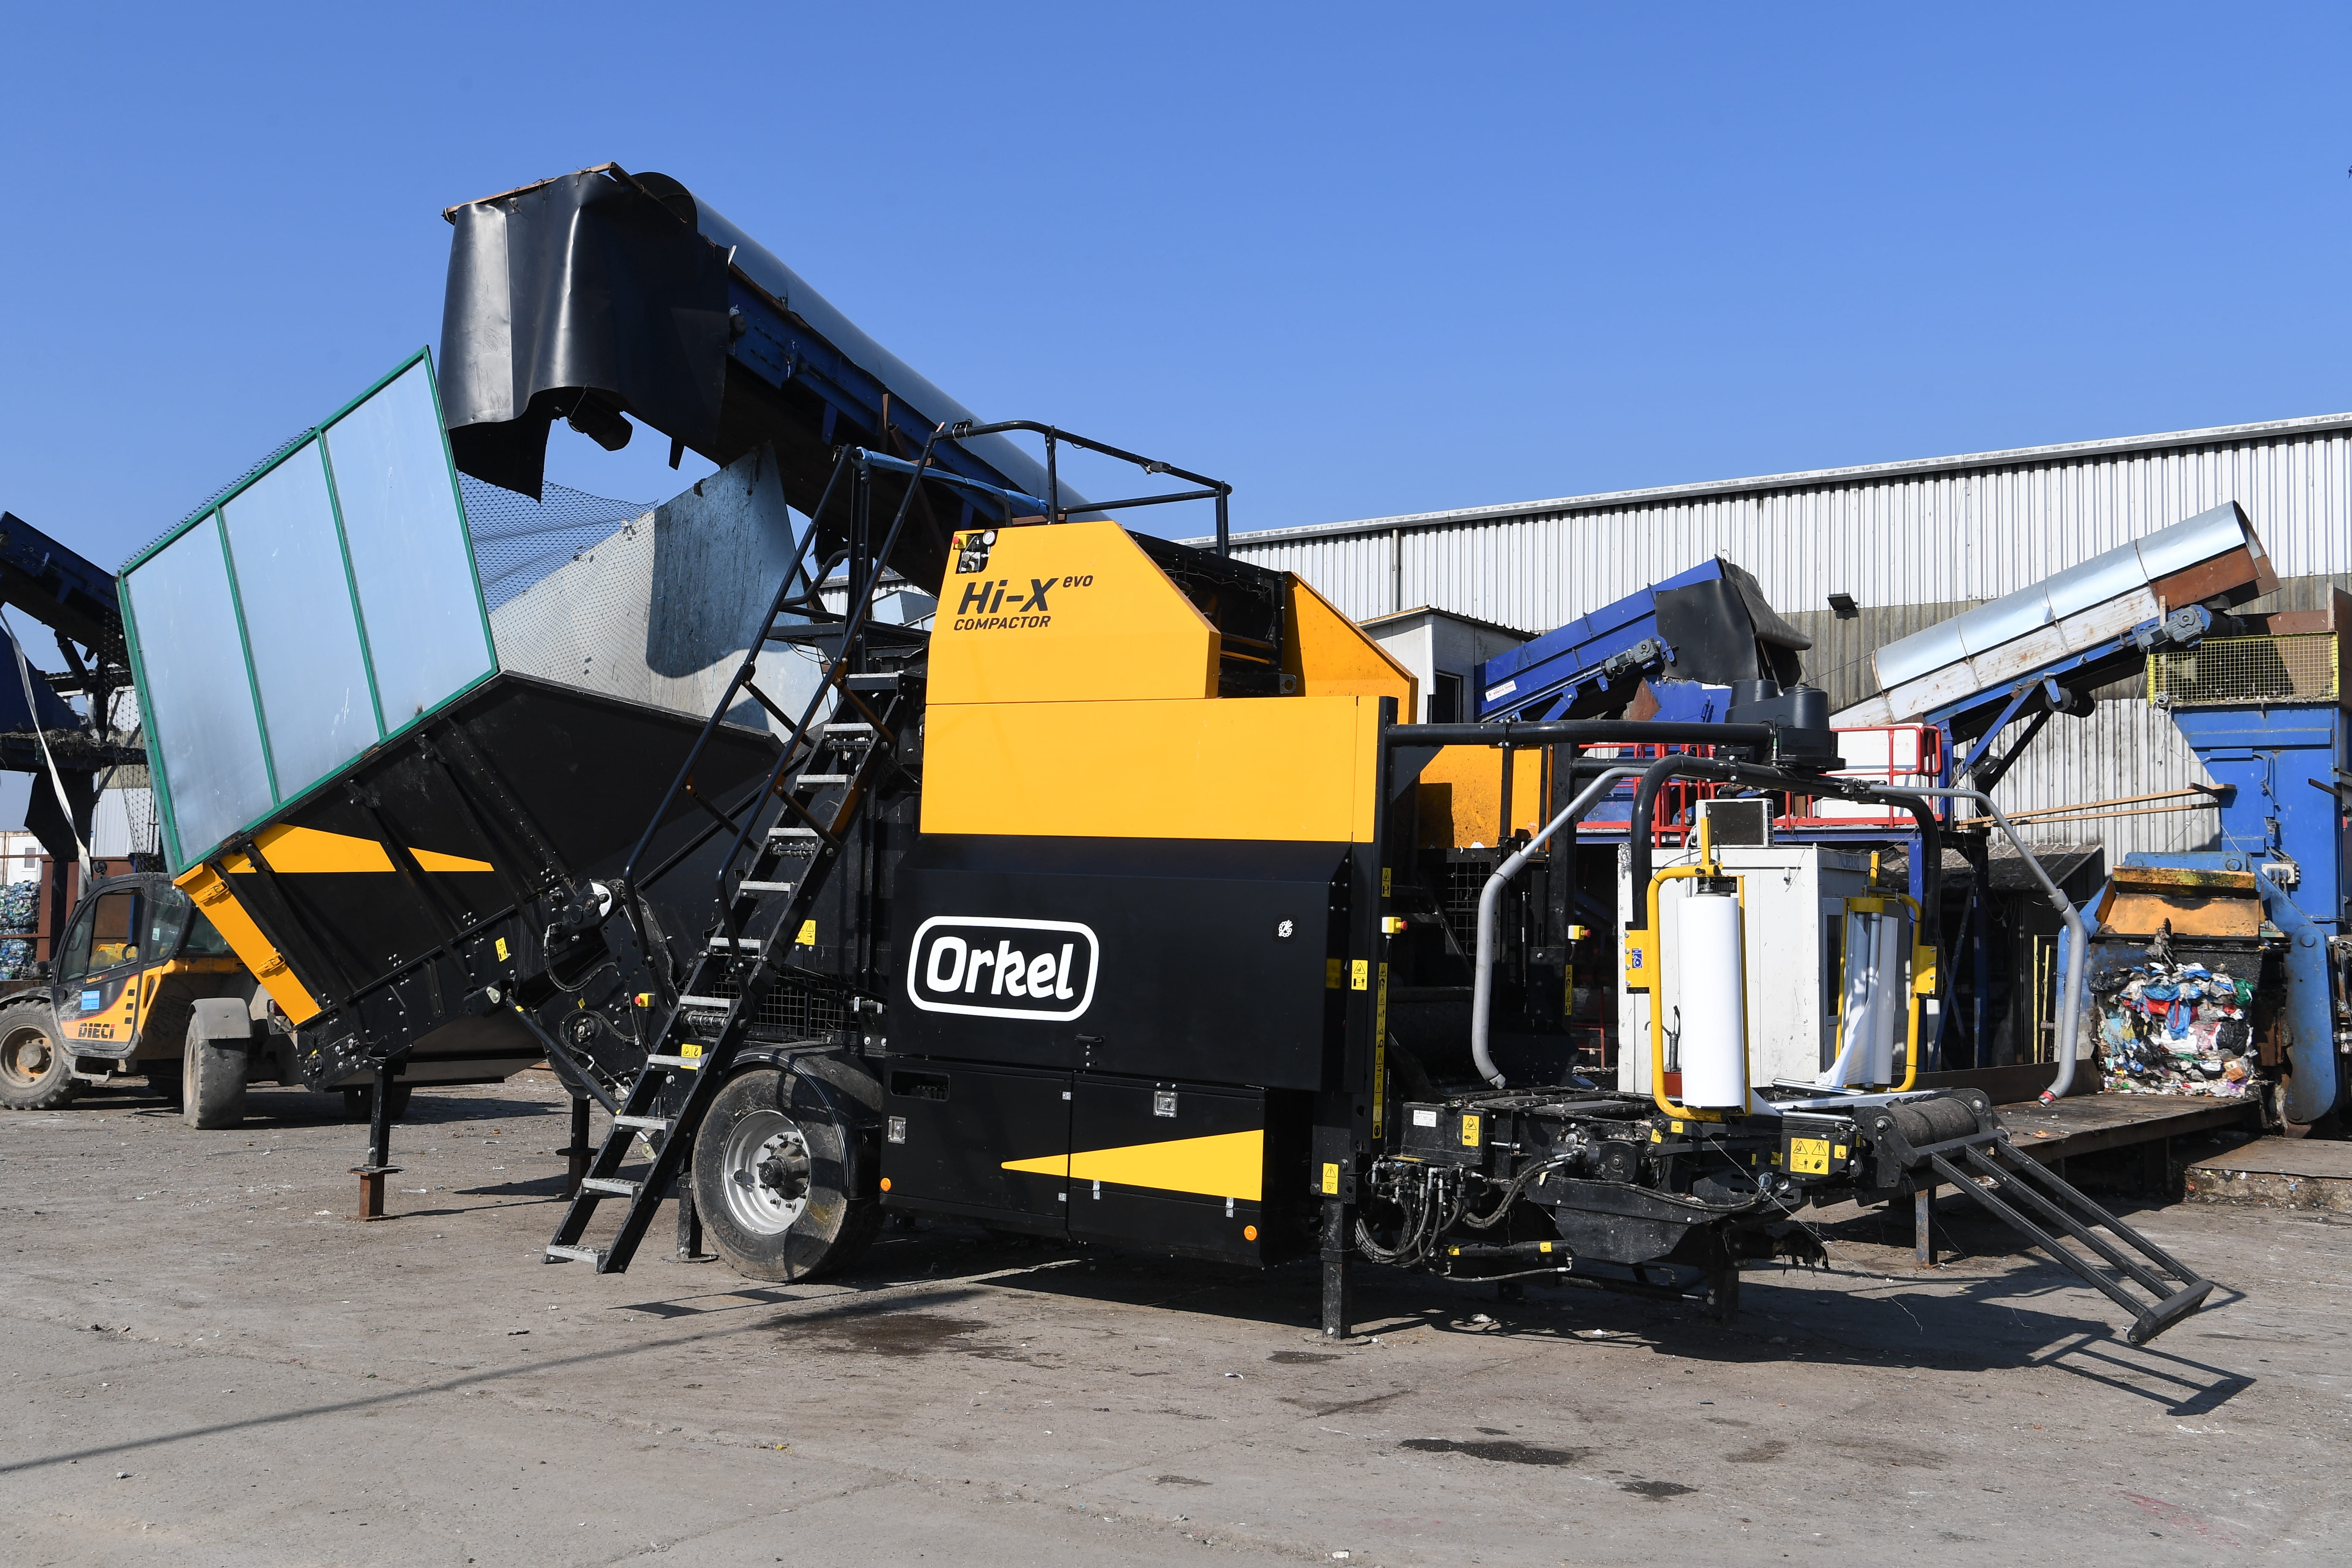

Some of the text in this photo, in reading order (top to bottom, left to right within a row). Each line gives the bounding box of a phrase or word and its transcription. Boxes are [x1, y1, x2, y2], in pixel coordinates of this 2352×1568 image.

[957, 575, 1093, 615] Hi-X evo
[953, 615, 1051, 631] COMPACTOR
[926, 936, 1074, 1000] Orkel
